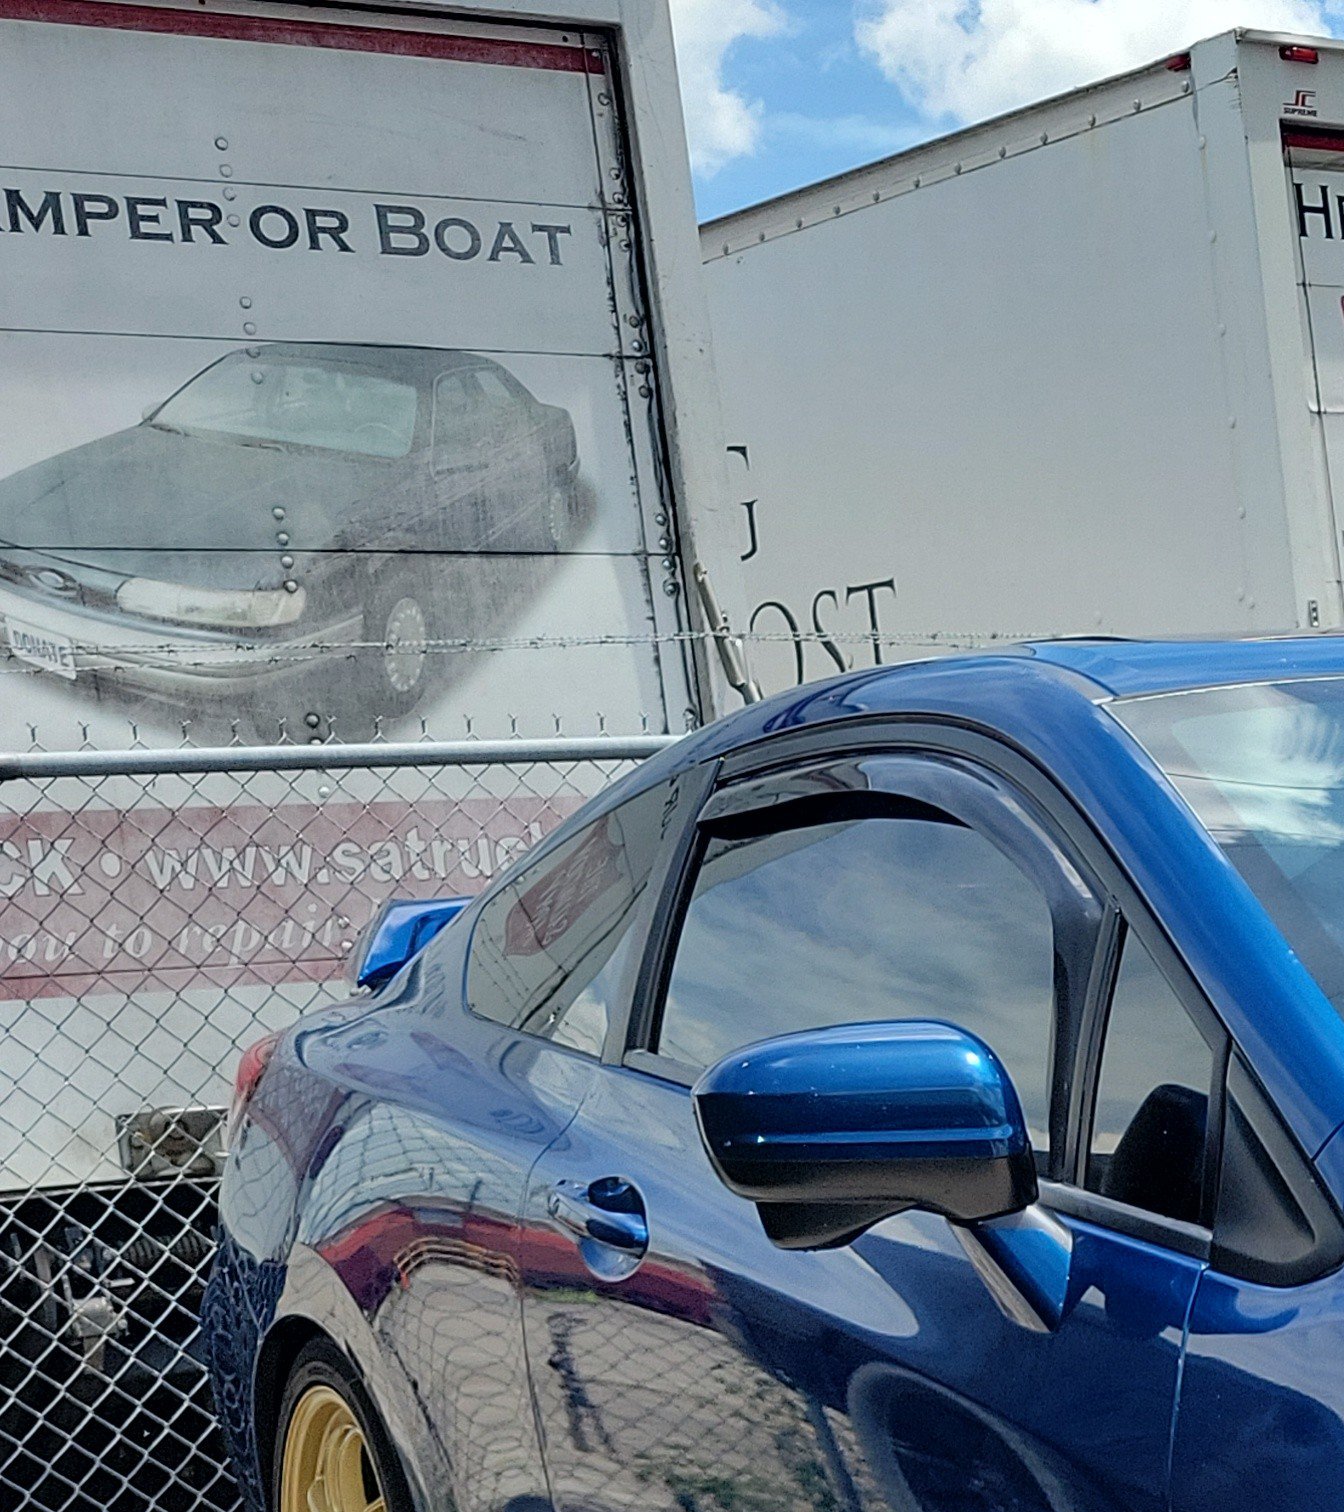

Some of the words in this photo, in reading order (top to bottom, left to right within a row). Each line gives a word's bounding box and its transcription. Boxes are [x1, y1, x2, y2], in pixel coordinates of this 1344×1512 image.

[0, 188, 229, 245] MPER
[249, 204, 356, 253] OR
[373, 204, 572, 266] BOAT
[102, 921, 152, 958] to
